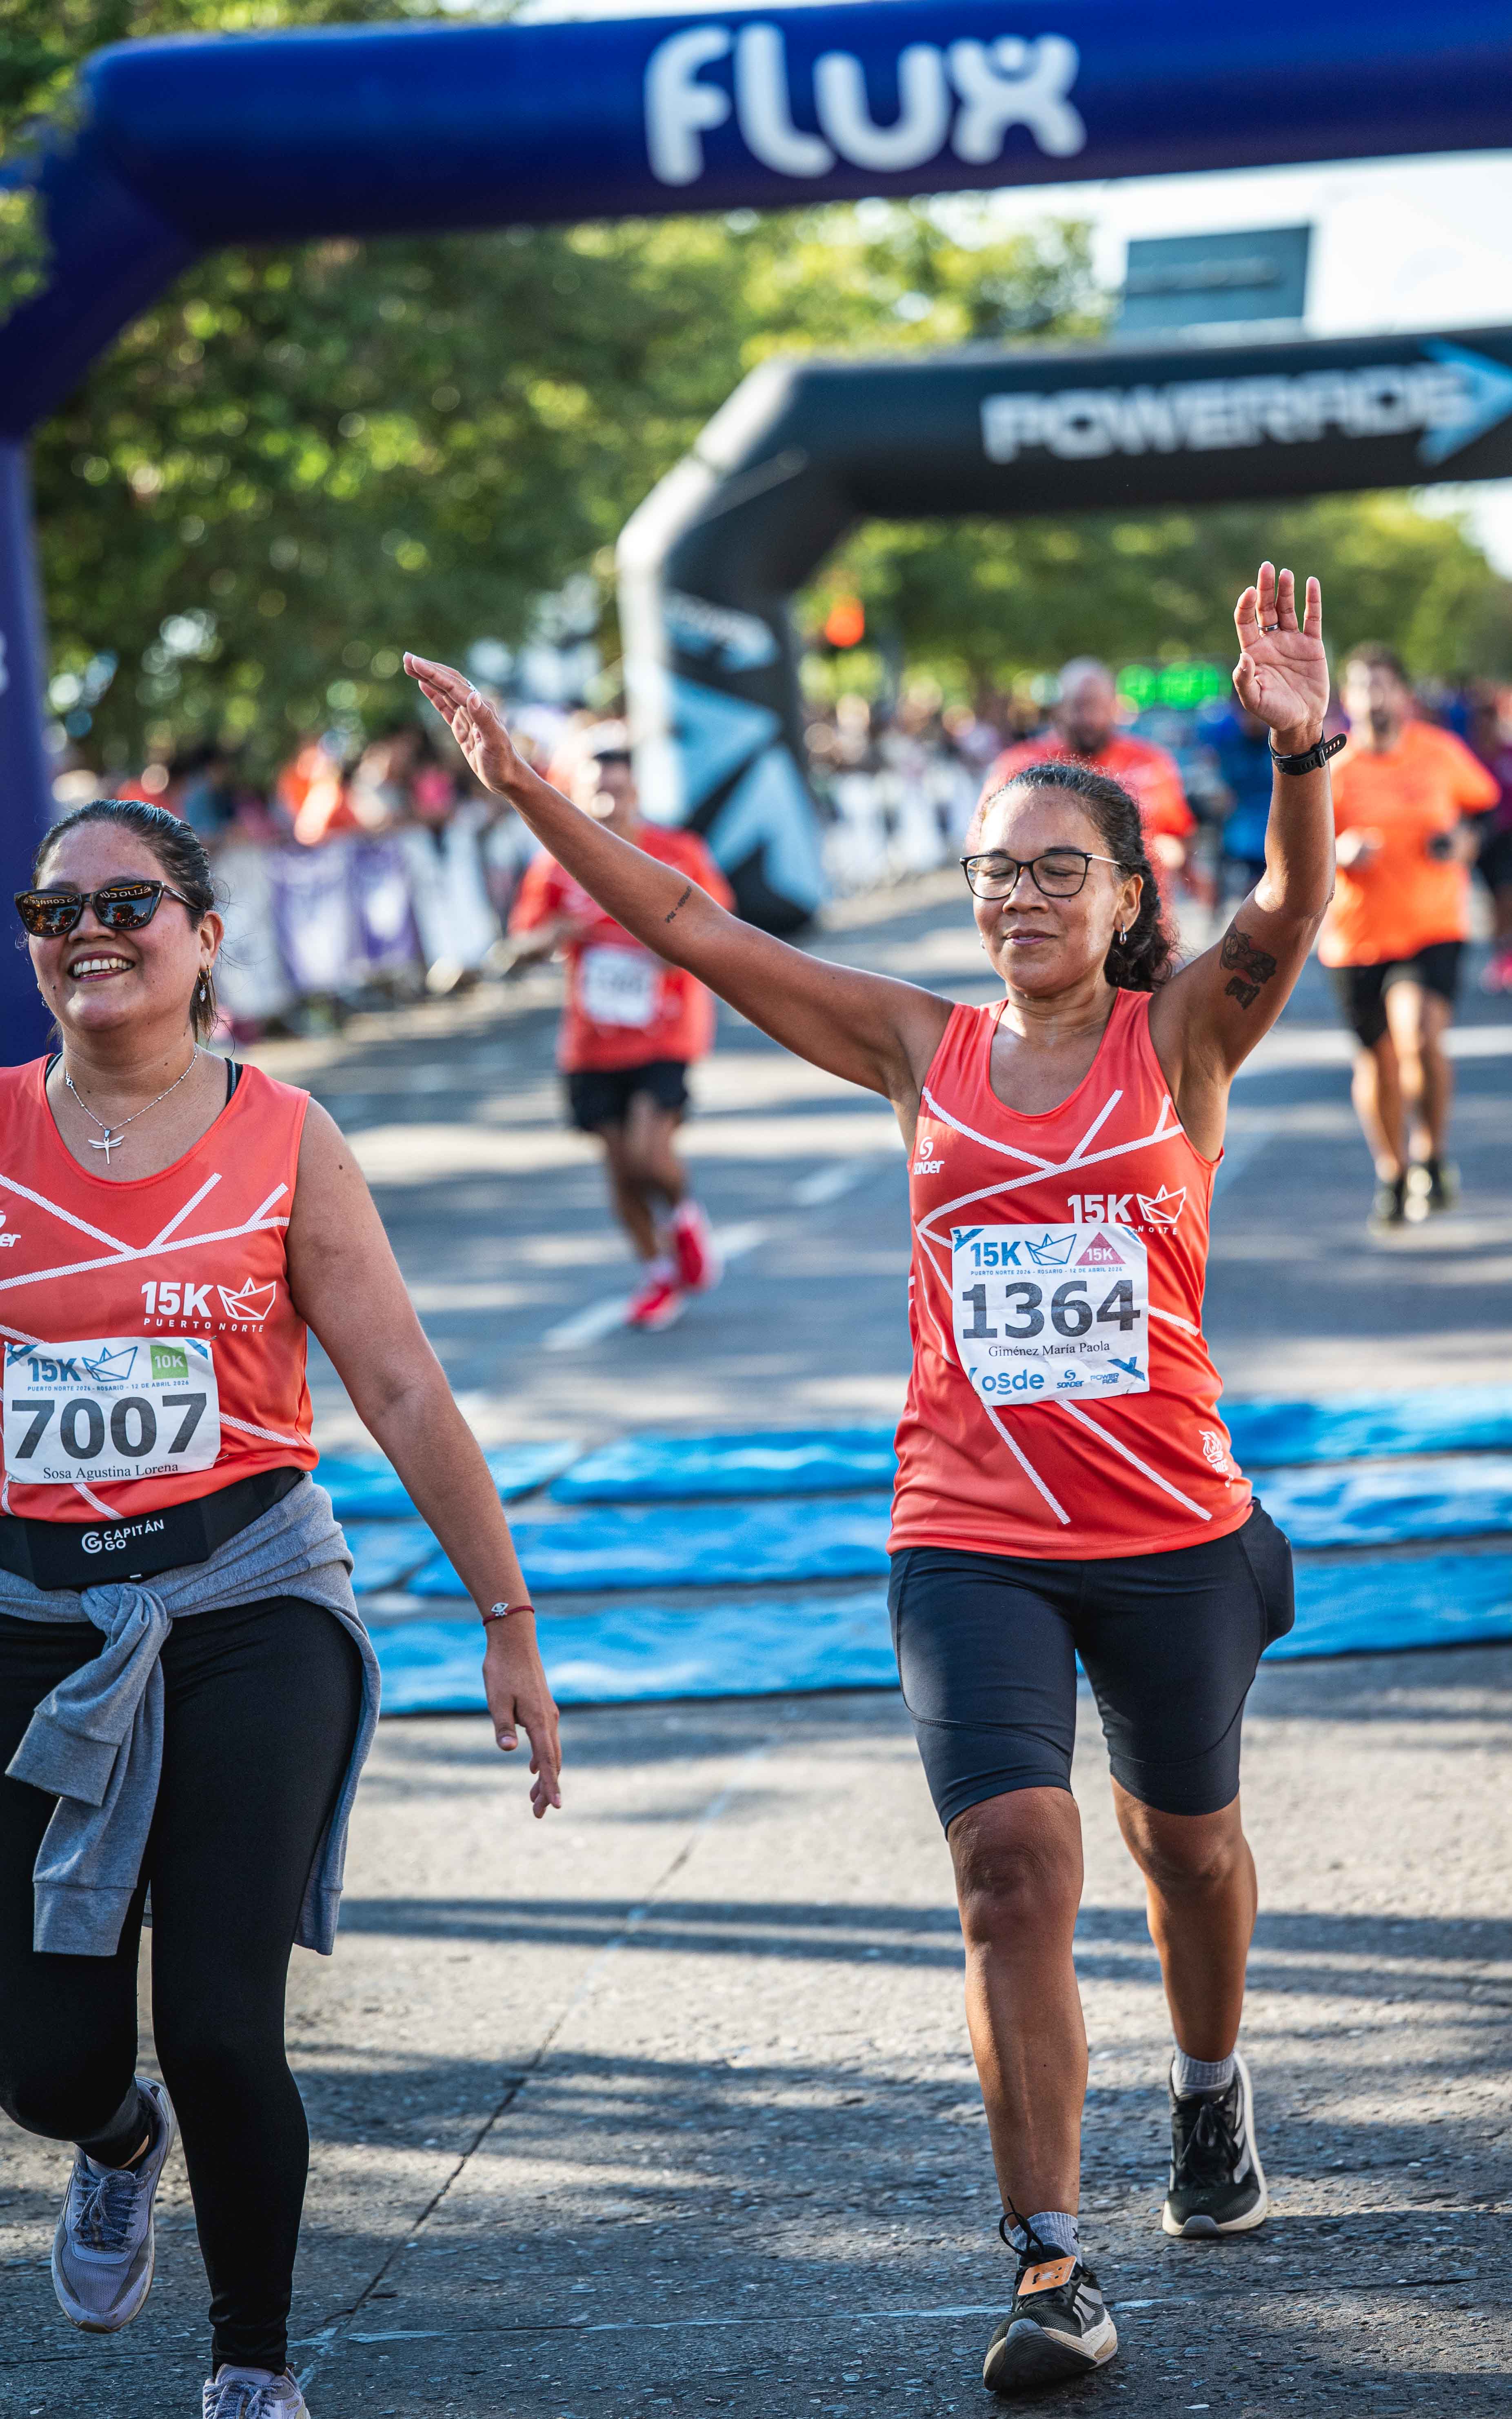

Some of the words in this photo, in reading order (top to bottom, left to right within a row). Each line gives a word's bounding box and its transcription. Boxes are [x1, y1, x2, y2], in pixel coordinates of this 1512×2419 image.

[1067, 1194, 1134, 1224] 15K
[970, 1241, 1021, 1267] 15K
[1086, 1248, 1114, 1262] 15K
[141, 1281, 214, 1317] 15K
[962, 1280, 1141, 1339] 1364
[144, 1318, 211, 1329] PUERTO
[219, 1323, 264, 1333] NORTE
[988, 1345, 1039, 1357] Giménez
[1043, 1344, 1076, 1356] María
[1080, 1341, 1110, 1353] Paola
[27, 1357, 82, 1382] 15K
[155, 1355, 184, 1368] 10K
[982, 1369, 1044, 1392] osde
[12, 1393, 207, 1459] 7007
[43, 1467, 71, 1479] Sosa
[76, 1466, 131, 1481] Agustina
[135, 1463, 179, 1476] Lorena
[103, 1519, 164, 1541] CAPITÁN
[105, 1539, 126, 1551] GO
